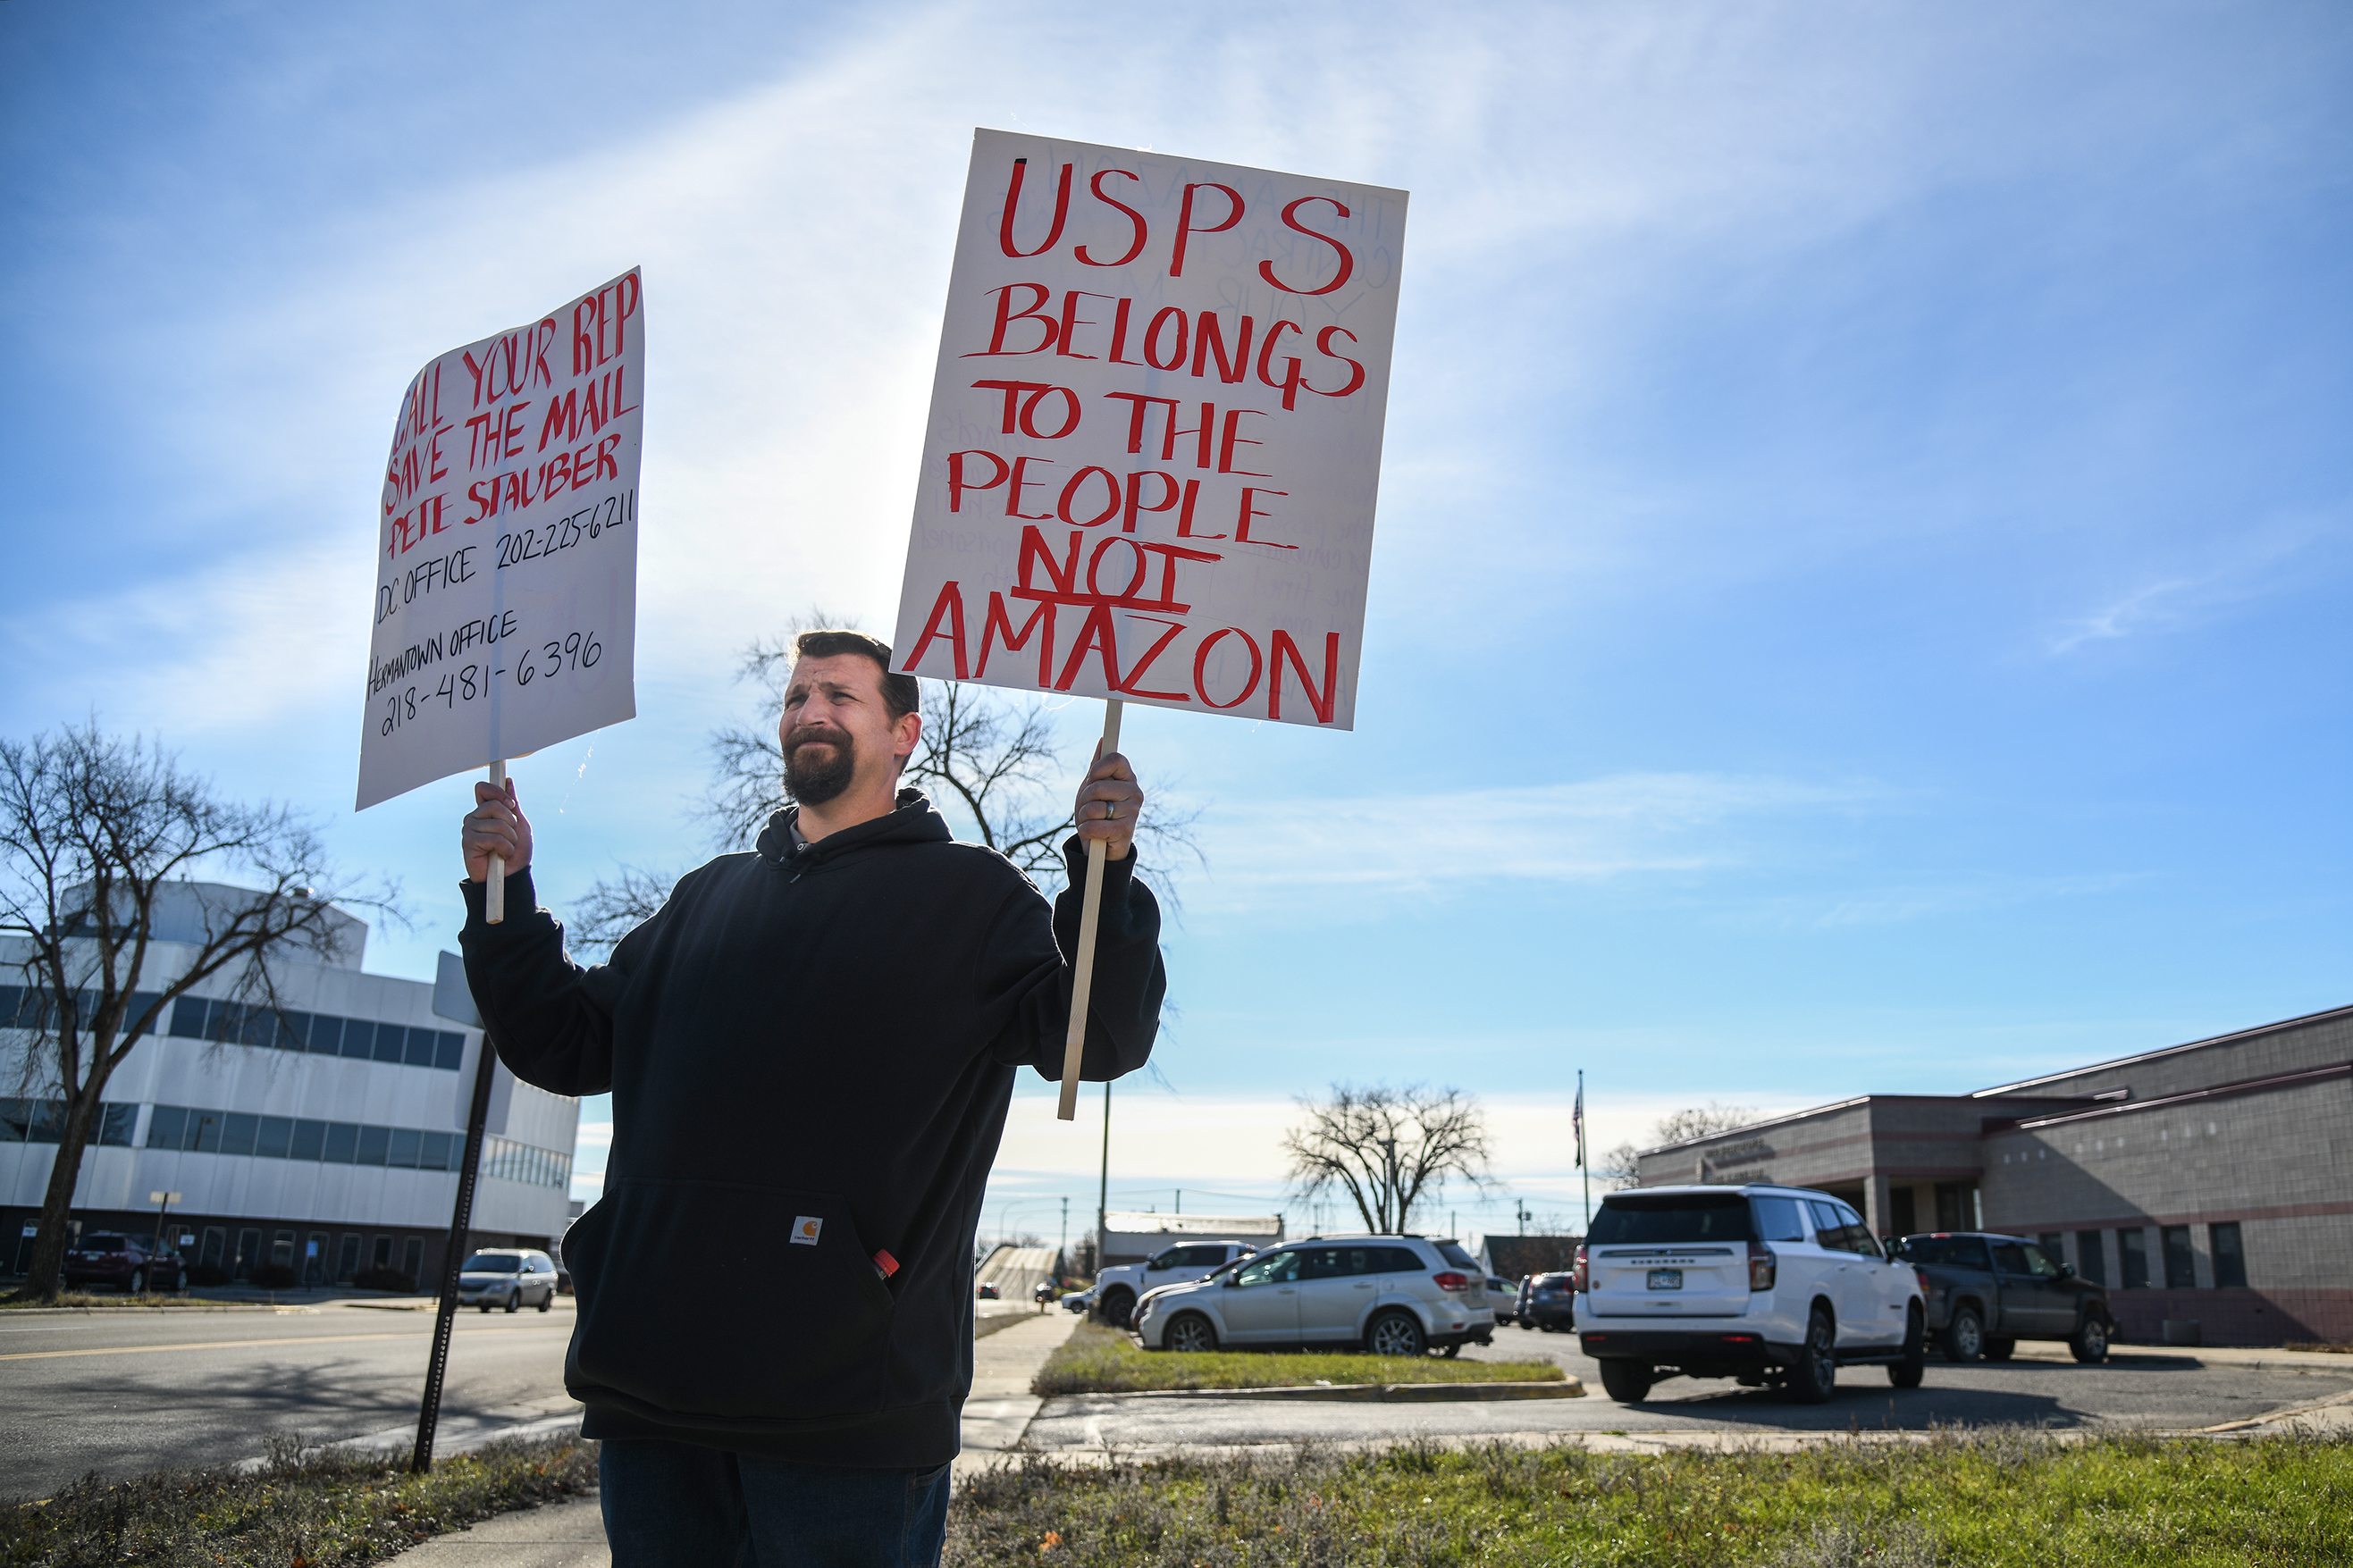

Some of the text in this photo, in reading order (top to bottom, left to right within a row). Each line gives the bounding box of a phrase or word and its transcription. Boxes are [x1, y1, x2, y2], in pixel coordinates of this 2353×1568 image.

[999, 157, 1354, 296] USPS
[392, 273, 640, 457] CALL YOUR REP
[957, 282, 1366, 412] BELONGS
[385, 364, 640, 516] SAVE THE MAIL
[970, 379, 1274, 478] TO THE
[386, 433, 621, 561] PETE STAUBER
[404, 545, 477, 605] OFFICE
[496, 489, 634, 570] 202-225-6211
[946, 449, 1300, 550] PEOPLE
[1018, 524, 1226, 606] NOT
[367, 610, 518, 702] HERMANTOWN OFFICE
[382, 631, 602, 737] 218-481-6396
[901, 580, 1340, 725] AMAZON
